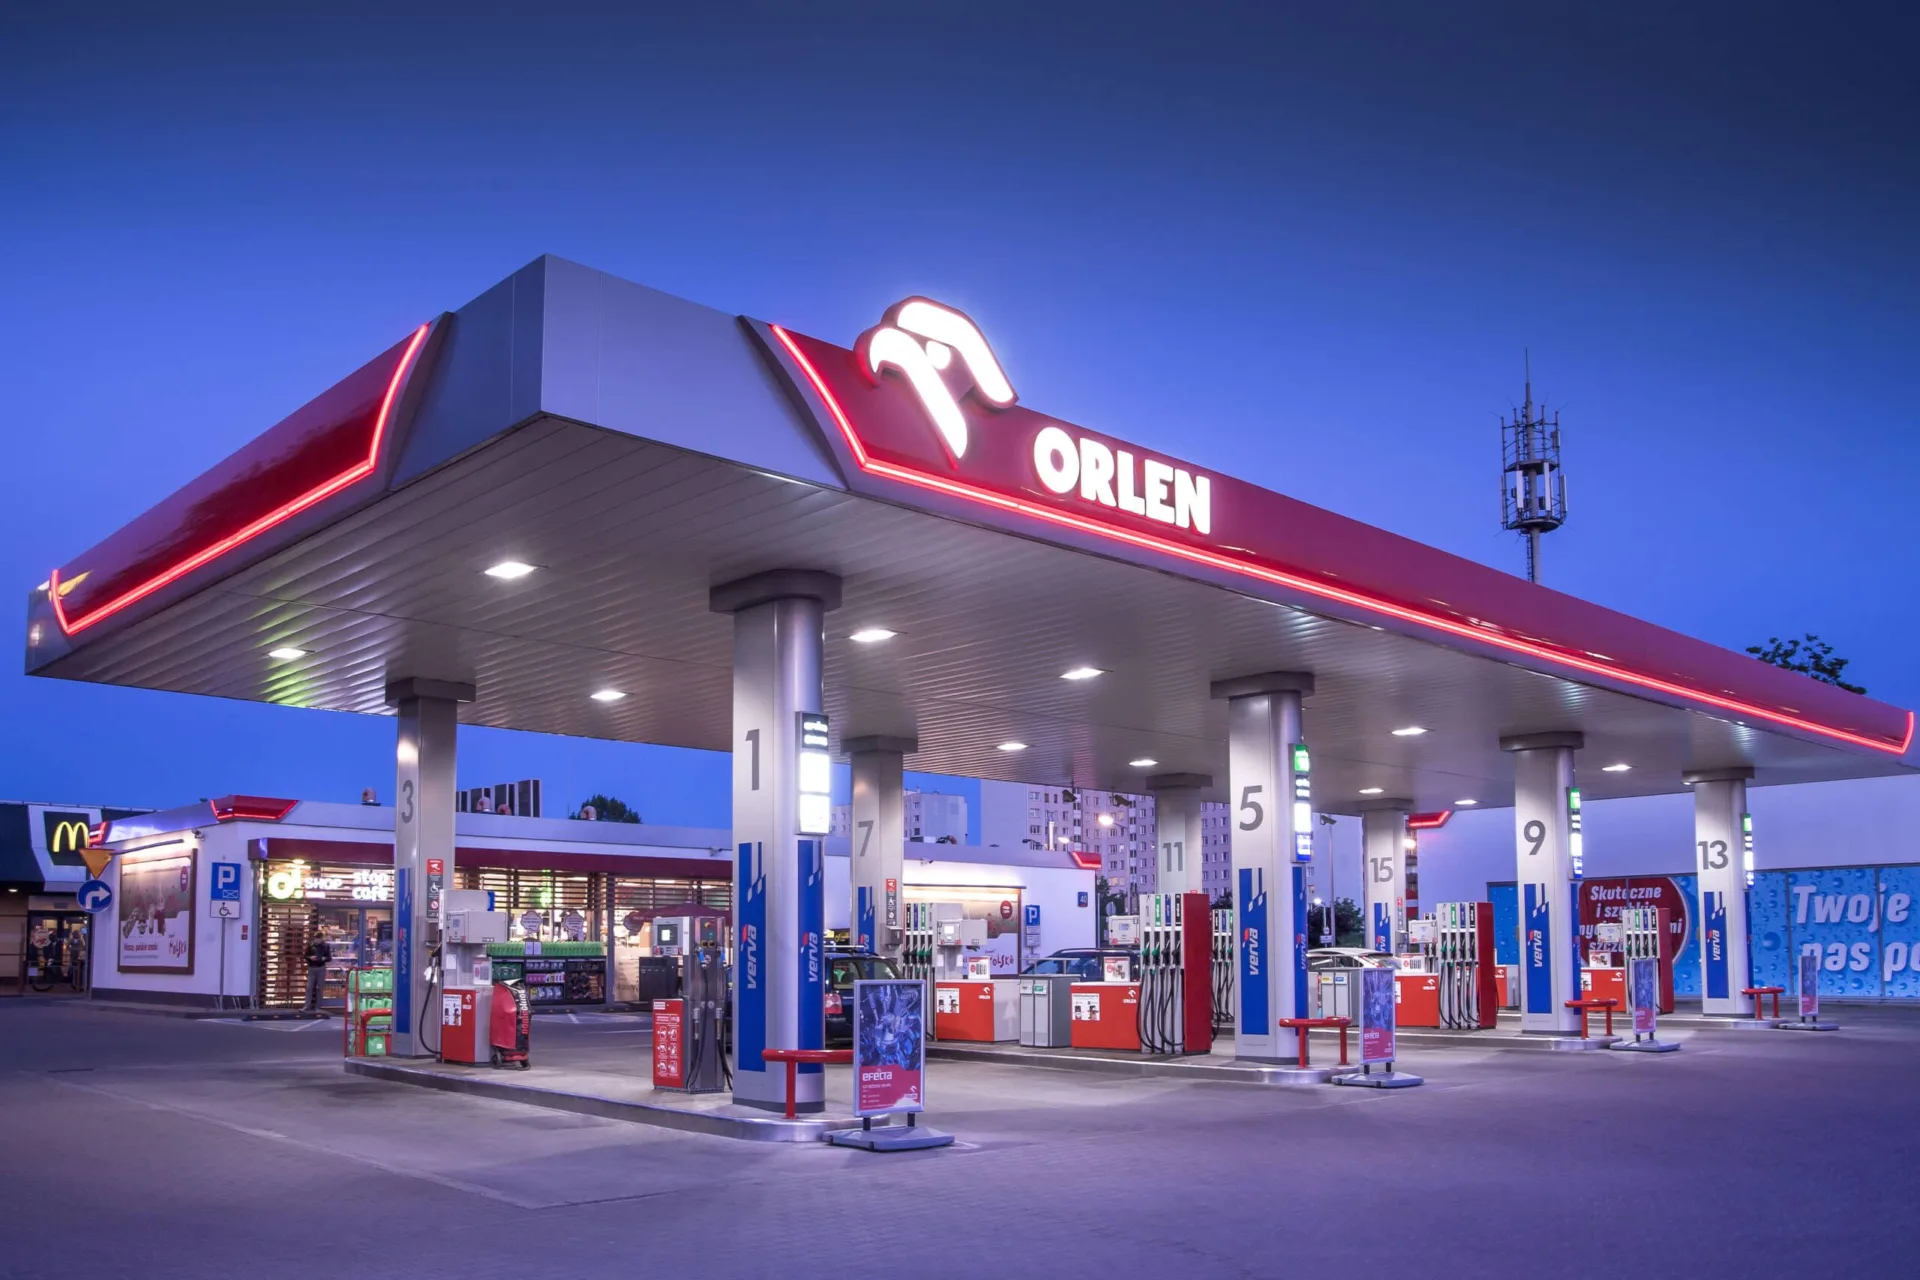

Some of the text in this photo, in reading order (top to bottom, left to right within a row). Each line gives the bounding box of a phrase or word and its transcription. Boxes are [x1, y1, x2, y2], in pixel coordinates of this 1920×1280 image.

[1033, 426, 1210, 535] ORLEN
[745, 729, 760, 791] 1
[402, 779, 414, 824] 3
[1239, 785, 1264, 831] 5
[858, 820, 874, 857] 7
[1523, 820, 1546, 856] 9
[1697, 840, 1729, 870] 13
[1163, 842, 1184, 872] 11
[1370, 857, 1394, 883] 15
[218, 866, 235, 889] P
[305, 878, 342, 889] SHOP
[353, 870, 388, 886] stop
[1027, 907, 1038, 923] P
[1793, 885, 1911, 933] Twoje
[747, 924, 757, 989] verva
[809, 932, 819, 982] verva
[1249, 928, 1260, 975] verva
[1534, 930, 1543, 967] verva
[1712, 929, 1721, 961] verva
[1802, 942, 1871, 971] nas
[862, 1071, 893, 1082] efecta
